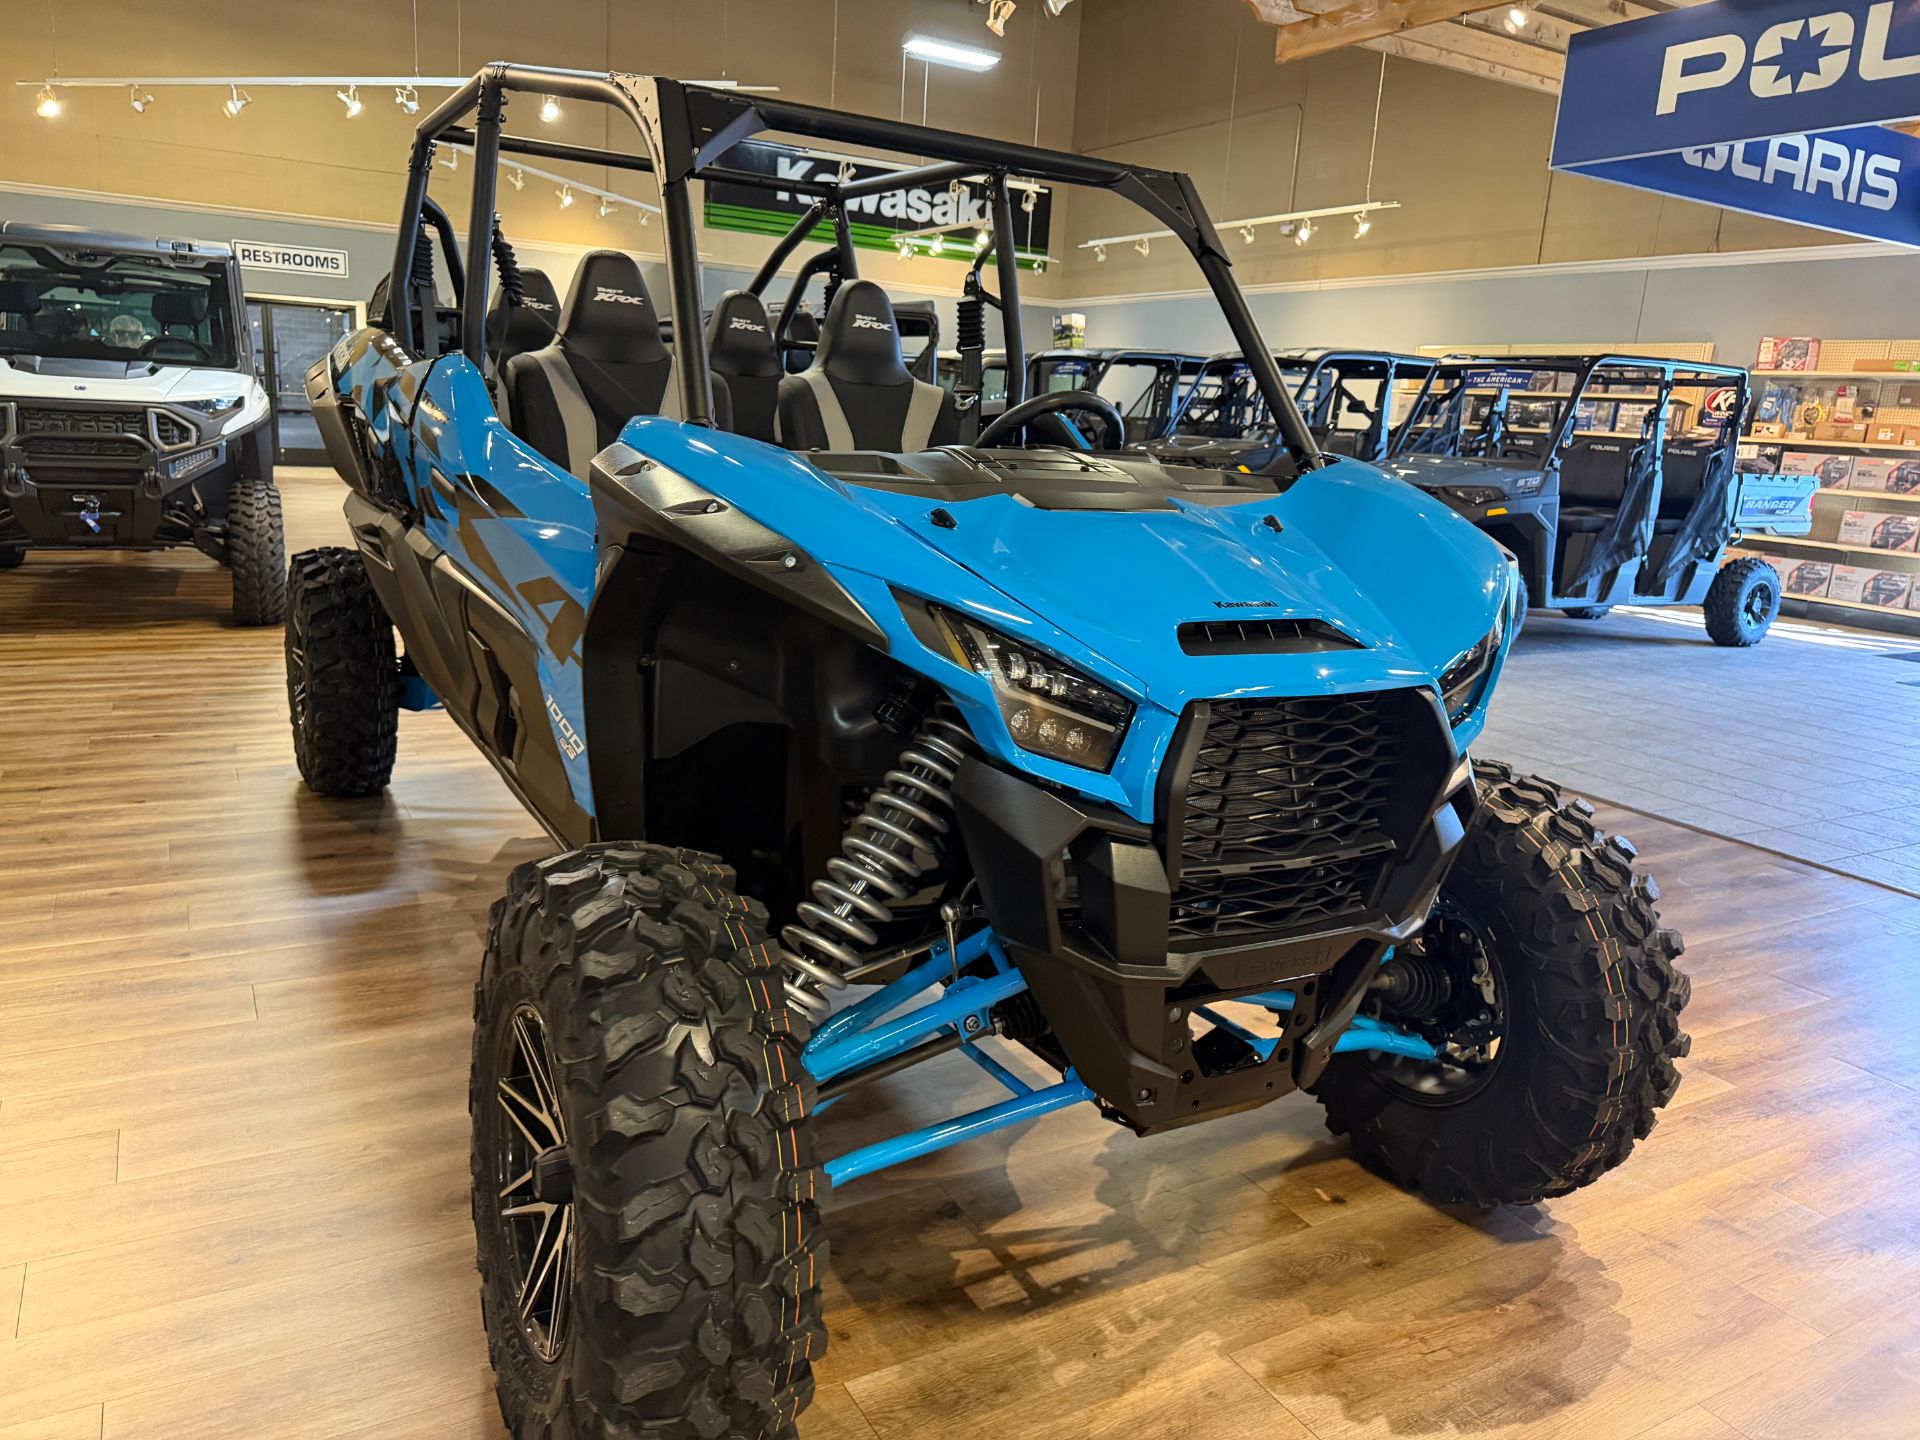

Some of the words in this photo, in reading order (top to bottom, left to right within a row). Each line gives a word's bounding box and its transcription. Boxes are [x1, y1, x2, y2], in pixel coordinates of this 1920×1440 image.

[242, 249, 340, 269] RESTROOMS
[593, 292, 644, 305] KRX
[1486, 376, 1524, 384] AMERICAN
[1745, 500, 1797, 510] RANGER
